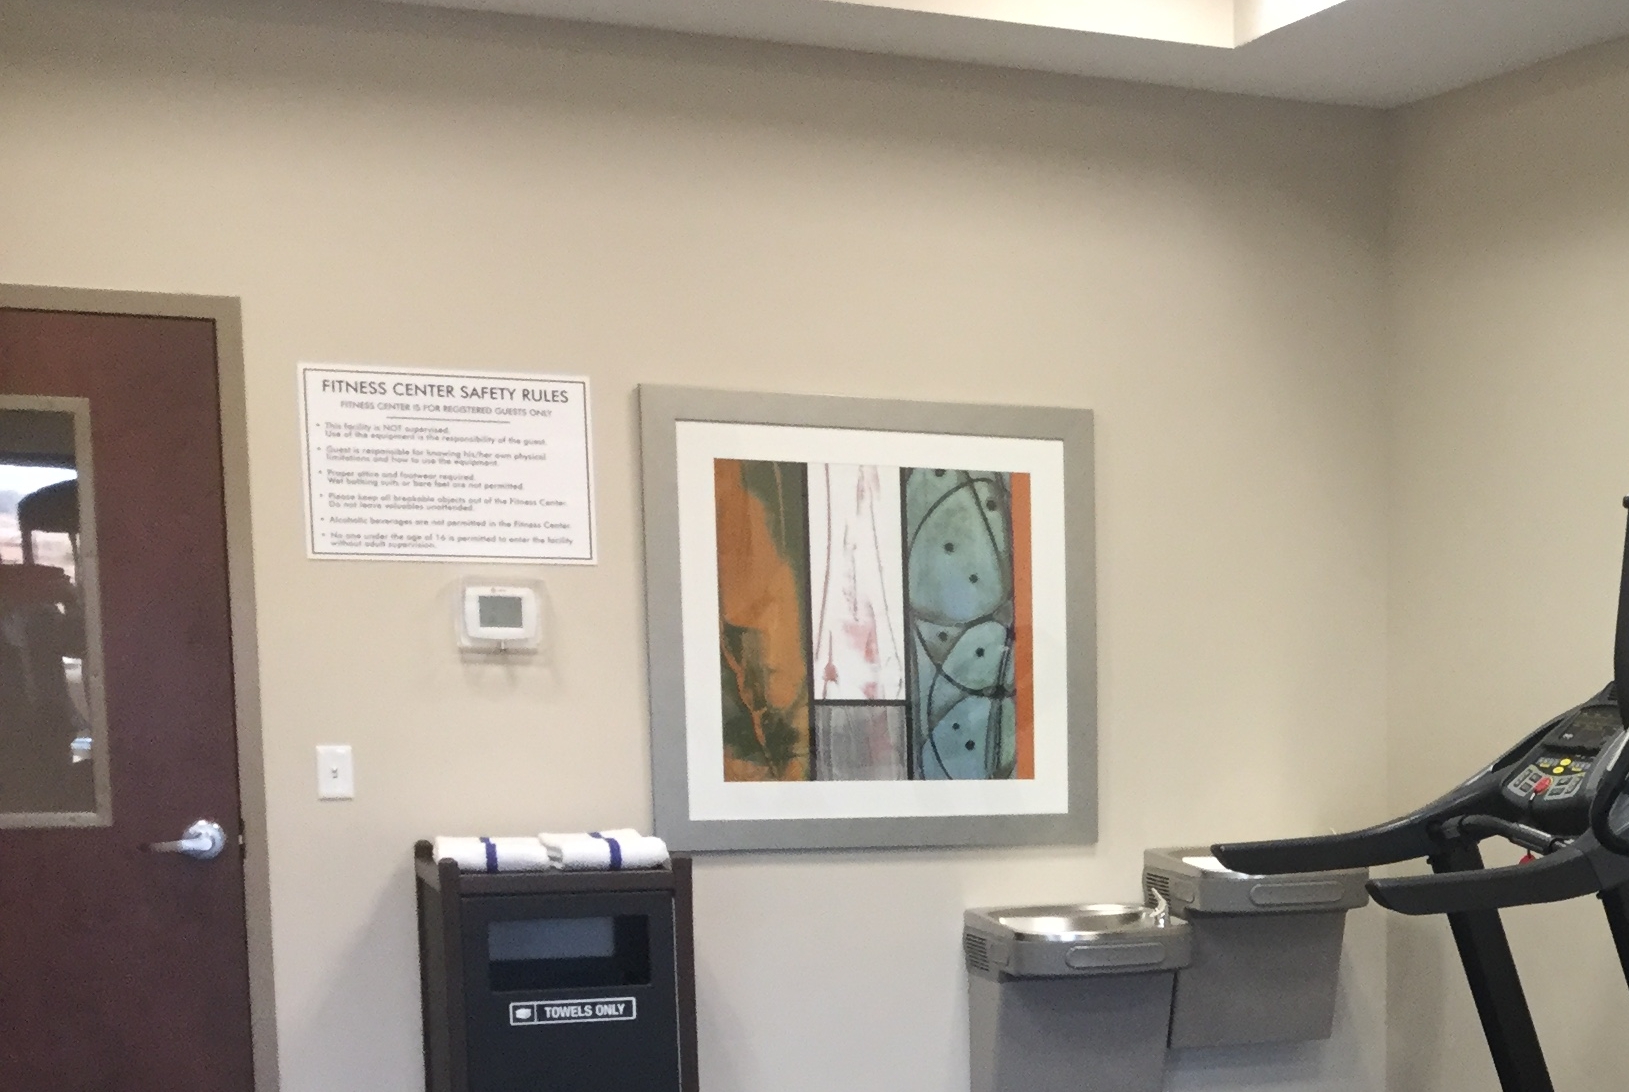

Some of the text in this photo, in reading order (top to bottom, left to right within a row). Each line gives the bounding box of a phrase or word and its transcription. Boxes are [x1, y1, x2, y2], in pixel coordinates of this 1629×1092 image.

[322, 379, 569, 403] FITNESS CENTER SAFETY RULES
[340, 400, 374, 410] FITNESS
[377, 402, 410, 411] CENTER
[423, 404, 440, 412] FOR
[443, 405, 492, 414] REGISTERED
[495, 407, 527, 416] GUESTS
[529, 409, 552, 417] ONLY
[325, 422, 341, 430] This
[344, 422, 371, 432] facility
[383, 424, 402, 432] NOT
[325, 430, 341, 438] Use
[371, 432, 415, 440] equipment
[426, 434, 439, 442] the
[442, 435, 495, 444] responsibility
[326, 445, 351, 453] Guest
[362, 448, 410, 456] responsible
[412, 448, 424, 456] for
[426, 450, 461, 458] knowing
[464, 450, 492, 459] his/her
[514, 452, 546, 461] physical
[326, 453, 370, 461] limitations
[327, 468, 354, 477] Proper
[382, 470, 398, 478] and
[400, 471, 436, 479] footwear
[346, 478, 378, 487] bathing
[413, 480, 432, 488] bare
[434, 480, 450, 488] feet
[328, 492, 356, 500] Please
[394, 494, 434, 502] breakable
[438, 496, 466, 504] objects
[510, 498, 537, 506] Fitness
[328, 500, 341, 508] Do
[385, 502, 424, 510] valuables
[330, 516, 368, 524] Alcoholic
[370, 516, 412, 526] beverages
[447, 520, 486, 528] permitted
[498, 520, 512, 528] the
[514, 520, 542, 528] Fitness
[406, 534, 422, 542] age
[436, 534, 446, 542] 16
[457, 535, 496, 543] permitted
[532, 536, 545, 544] the
[548, 536, 573, 545] facility
[544, 1003, 625, 1019] TOWELS ONLY
